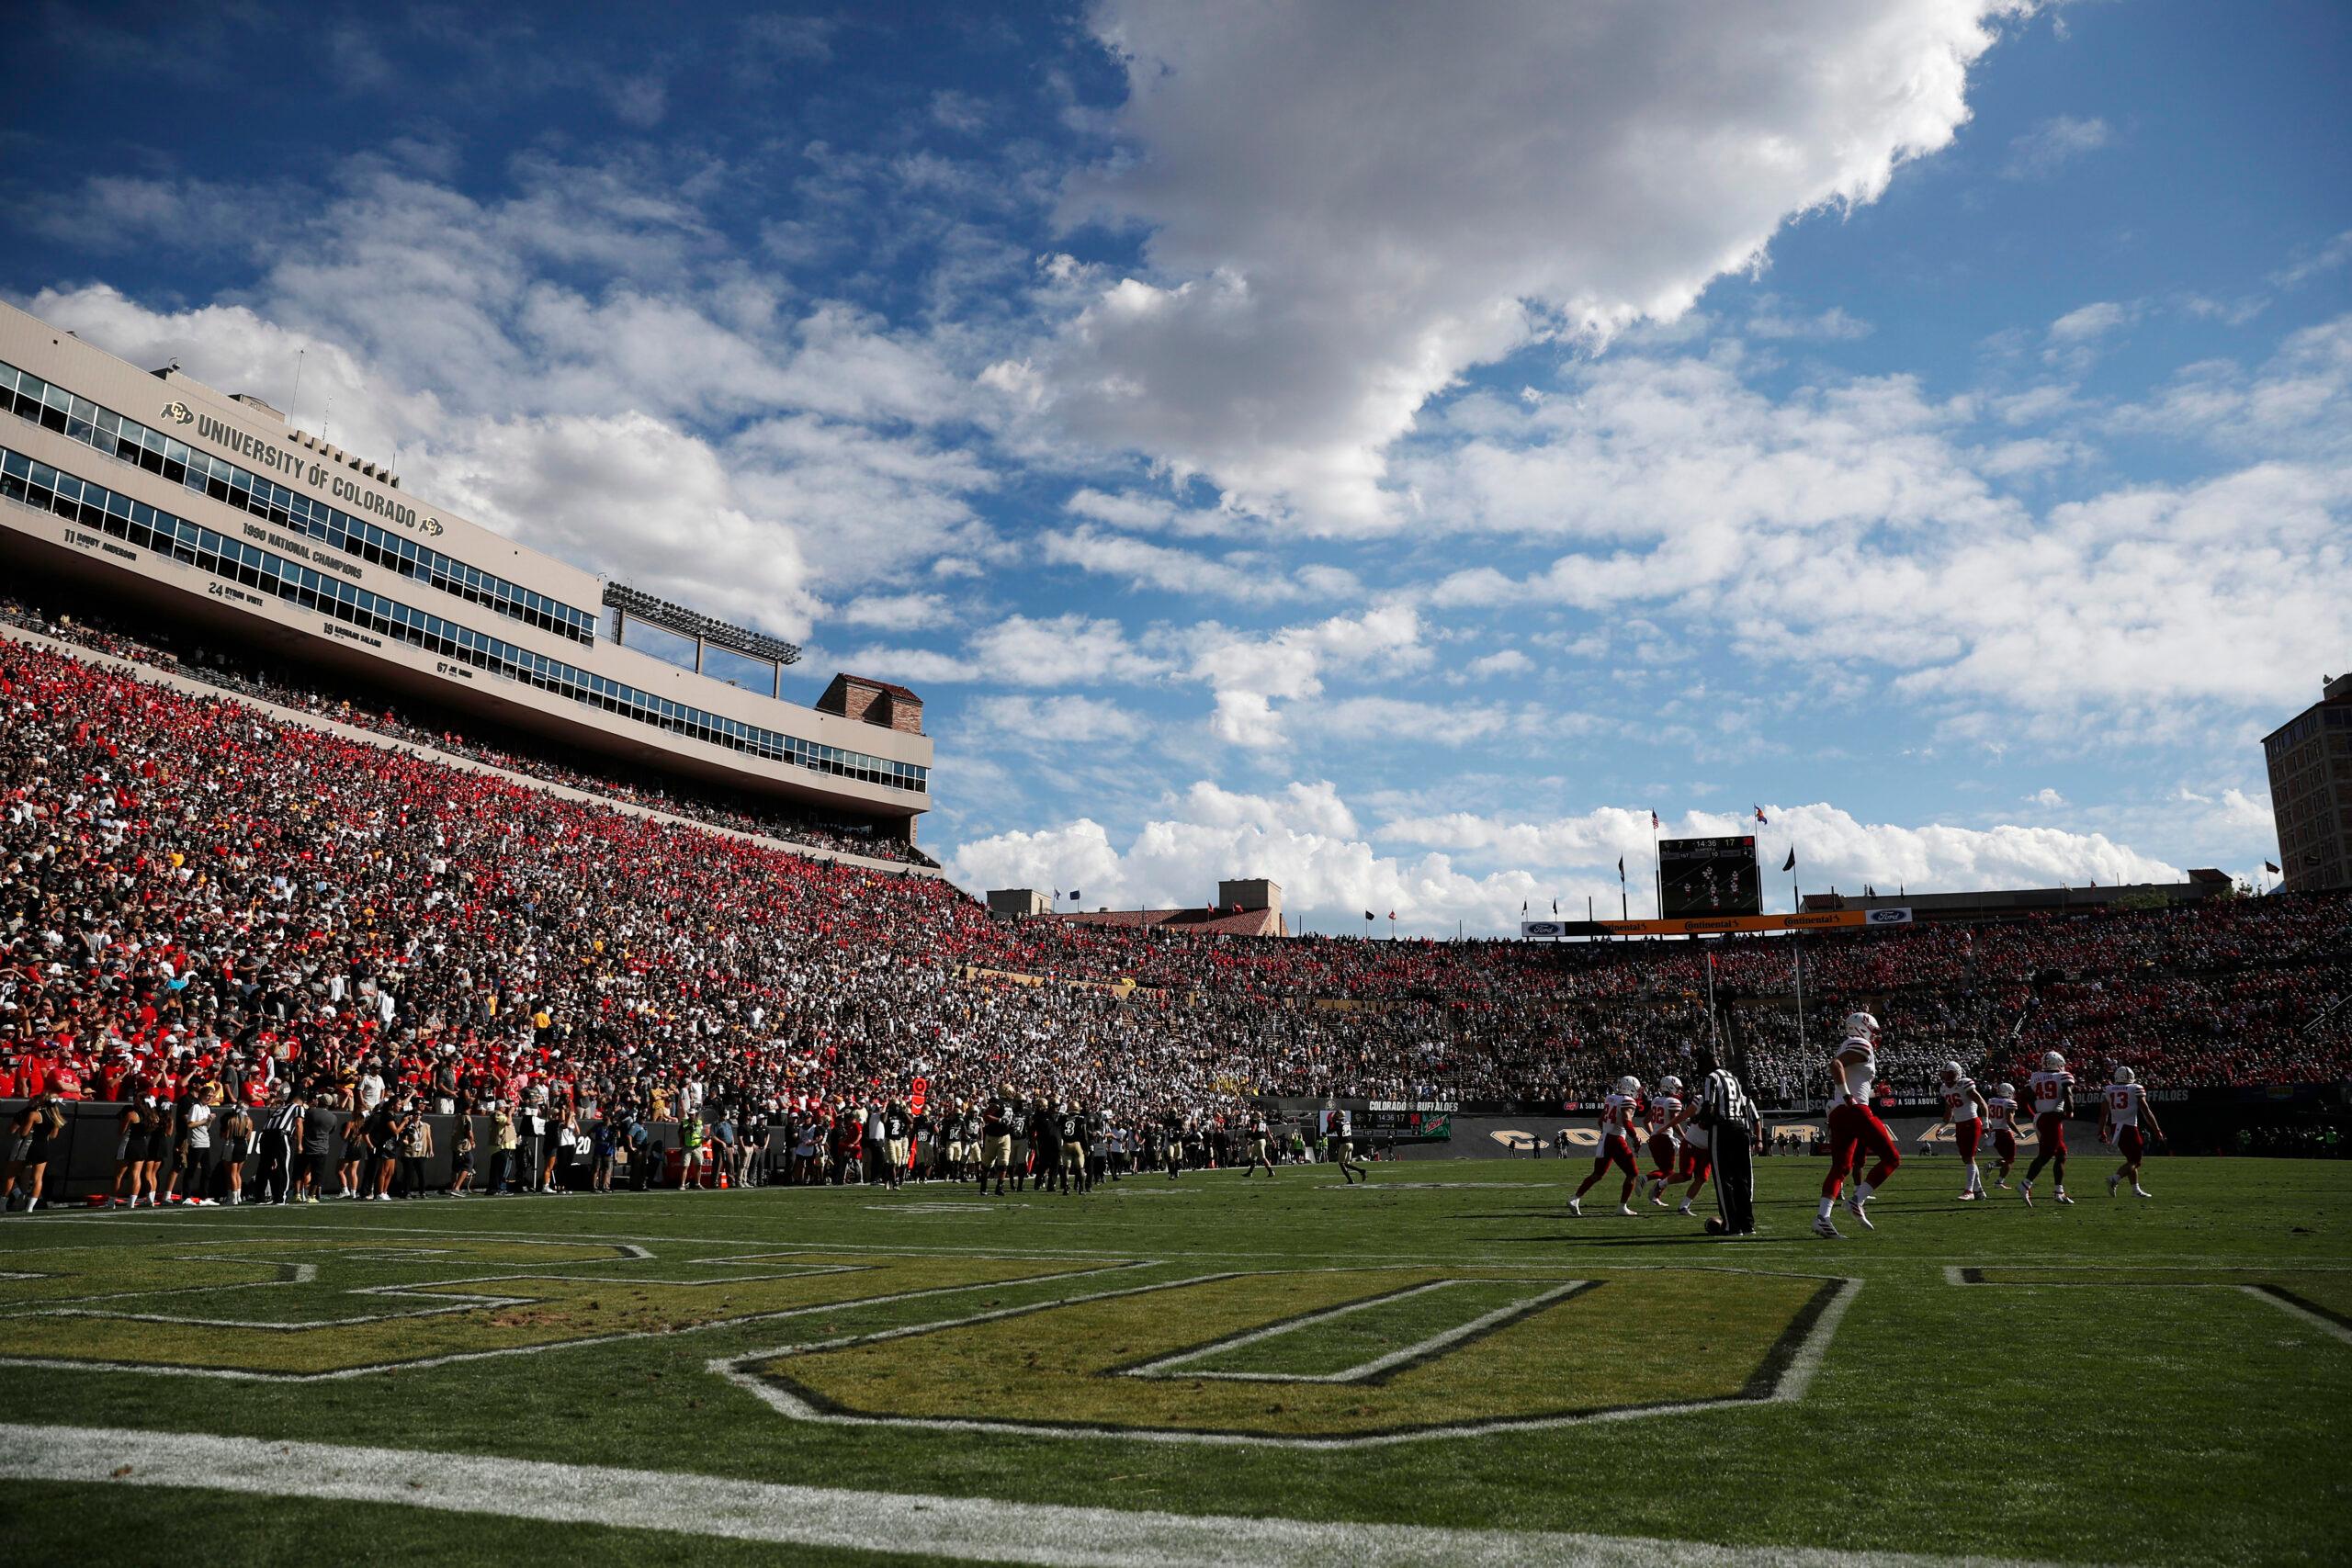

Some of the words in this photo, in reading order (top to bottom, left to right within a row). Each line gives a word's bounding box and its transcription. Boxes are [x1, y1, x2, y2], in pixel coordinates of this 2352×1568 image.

[198, 413, 305, 479] UNIVERSITY
[308, 465, 329, 490] OF
[333, 476, 416, 528] COLORADO
[64, 528, 75, 544] 11
[102, 542, 137, 561] ANDERSON
[243, 523, 266, 541] 1990
[268, 533, 311, 559] NATIONAL
[312, 550, 363, 580] CHAMPIONS
[209, 581, 223, 596] 24
[246, 594, 264, 607] WHITE
[323, 622, 334, 635] 19
[437, 661, 448, 673] 67
[1725, 839, 1735, 847] 17
[1784, 915, 1832, 926] Continental
[1877, 911, 1904, 921] Ford
[1533, 924, 1555, 933] Ford
[1685, 919, 1731, 931] Continental
[2034, 1081, 2057, 1100] 49
[1369, 1100, 1406, 1111] COLORADO
[1416, 1101, 1459, 1111] BUFFALOES
[1917, 1097, 1938, 1105] ABOVE.
[2110, 1092, 2128, 1110] 13
[1602, 1103, 1617, 1123] 24
[1988, 1105, 2004, 1119] 30
[891, 1122, 901, 1135] 2
[1063, 1121, 1076, 1136] 3
[576, 1135, 592, 1155] 20
